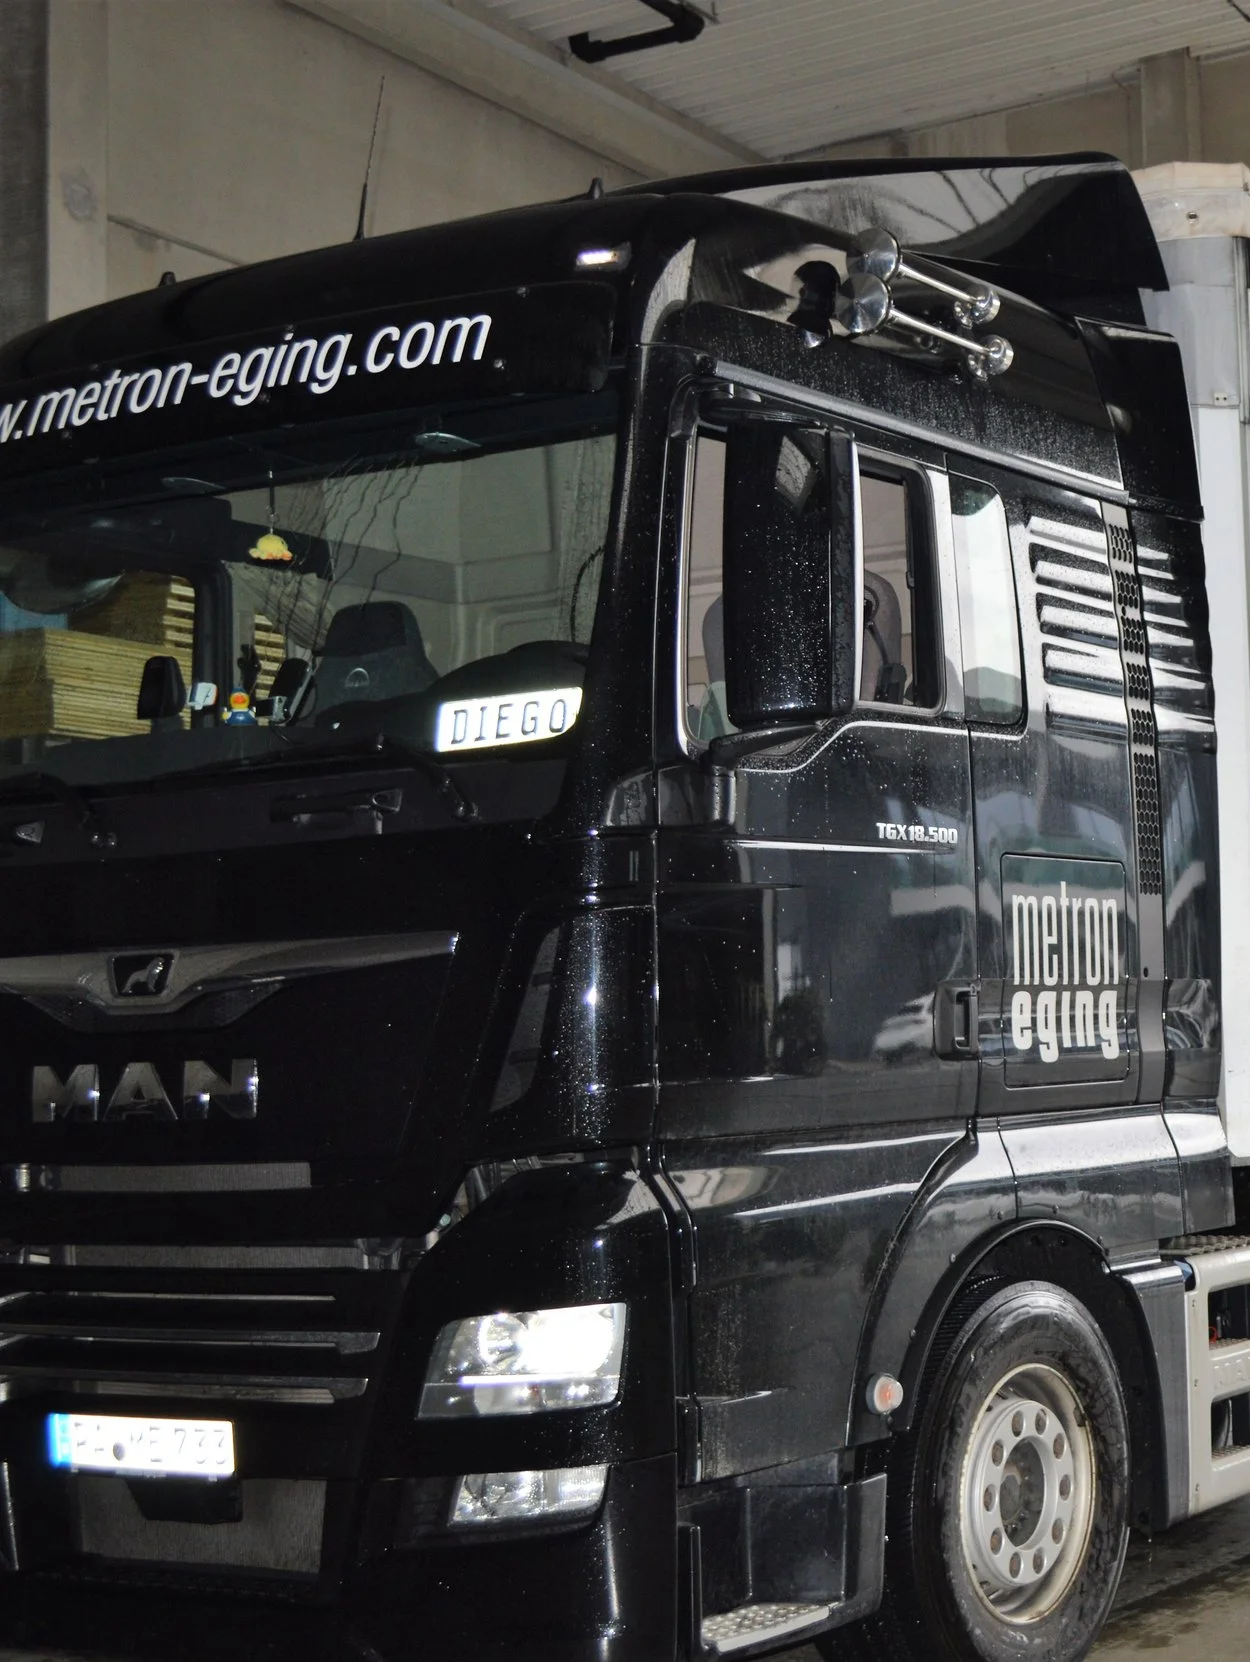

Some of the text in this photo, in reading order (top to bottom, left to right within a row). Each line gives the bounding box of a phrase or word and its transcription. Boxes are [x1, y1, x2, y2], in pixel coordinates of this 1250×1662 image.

[451, 699, 567, 745] DIEGO
[1012, 881, 1119, 986] metron
[1011, 990, 1119, 1063] eging
[32, 1058, 258, 1123] MAN
